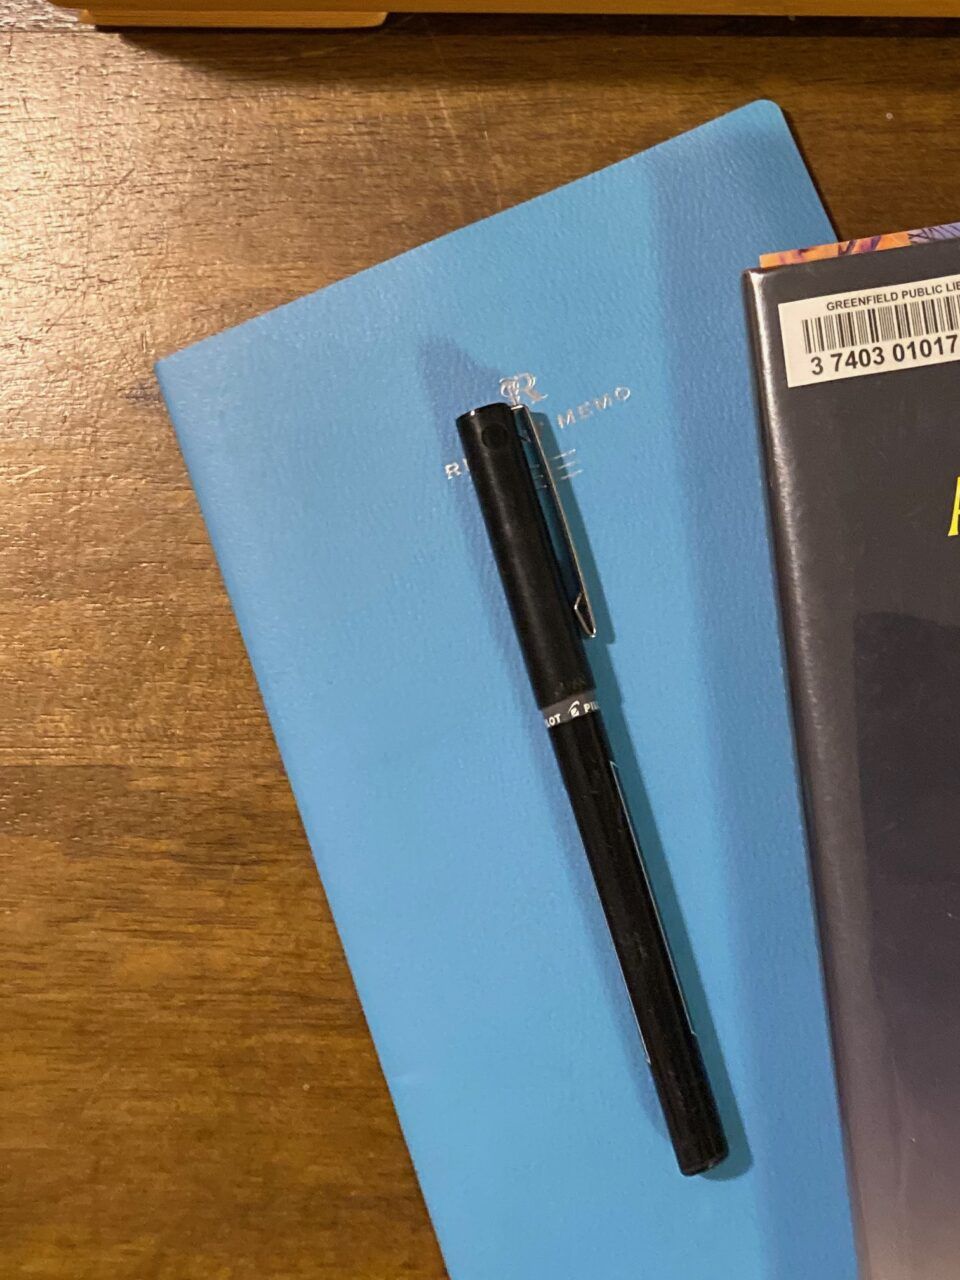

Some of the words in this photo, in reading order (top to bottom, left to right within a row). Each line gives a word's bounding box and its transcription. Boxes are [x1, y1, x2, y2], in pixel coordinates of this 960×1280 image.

[826, 291, 899, 312] GREENFIELD
[901, 283, 944, 301] PUBLIC
[811, 356, 825, 376] 3
[830, 346, 886, 372] 7403
[892, 334, 959, 363] 01017
[556, 385, 632, 429] MEMO
